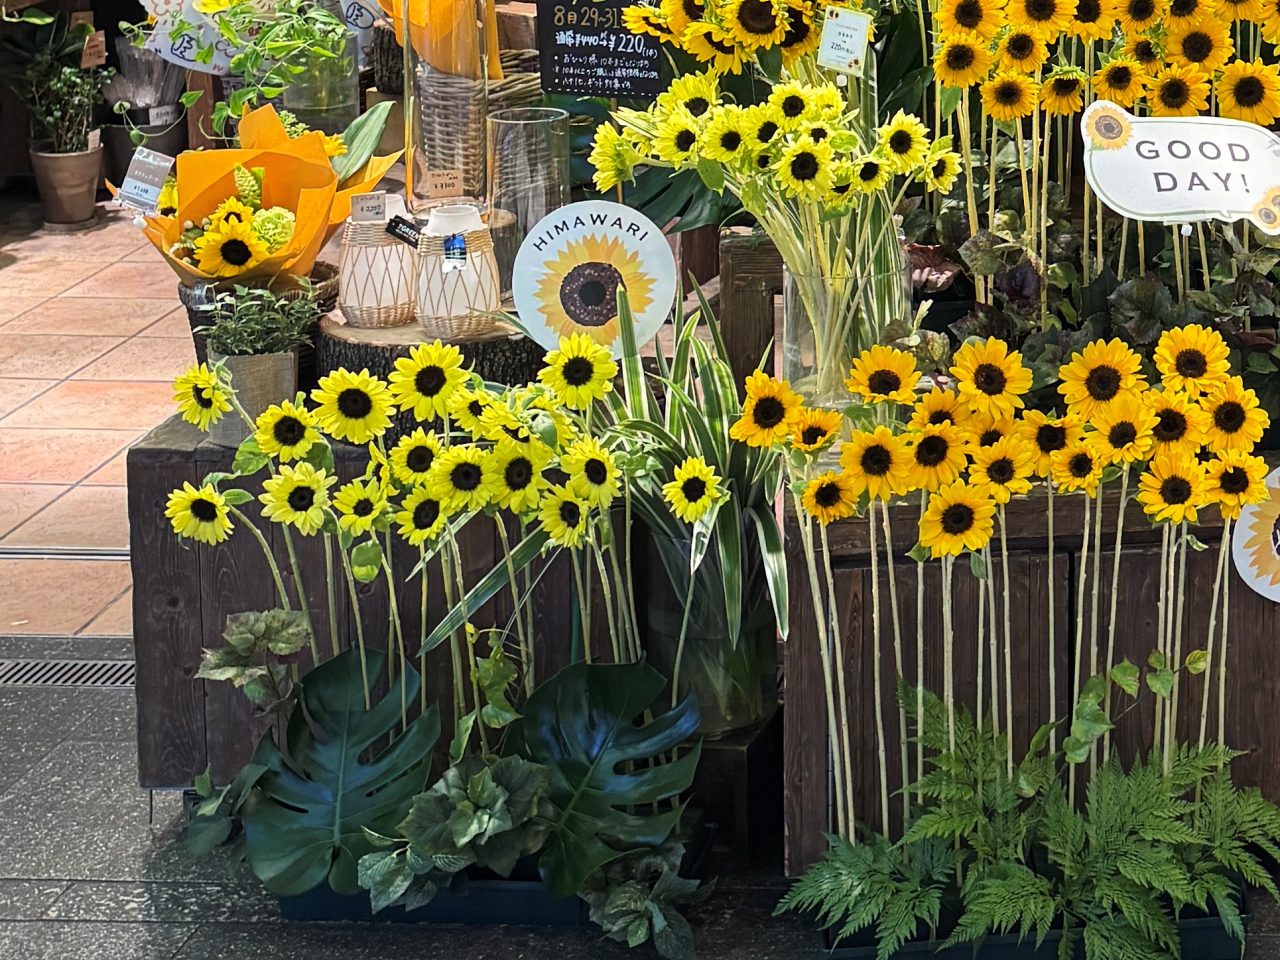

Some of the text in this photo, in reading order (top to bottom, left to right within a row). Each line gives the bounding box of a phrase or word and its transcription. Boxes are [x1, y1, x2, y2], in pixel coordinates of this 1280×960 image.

[1135, 140, 1250, 162] GOOD
[1153, 172, 1250, 193] DAY!
[533, 213, 650, 252] HIMAWARI
